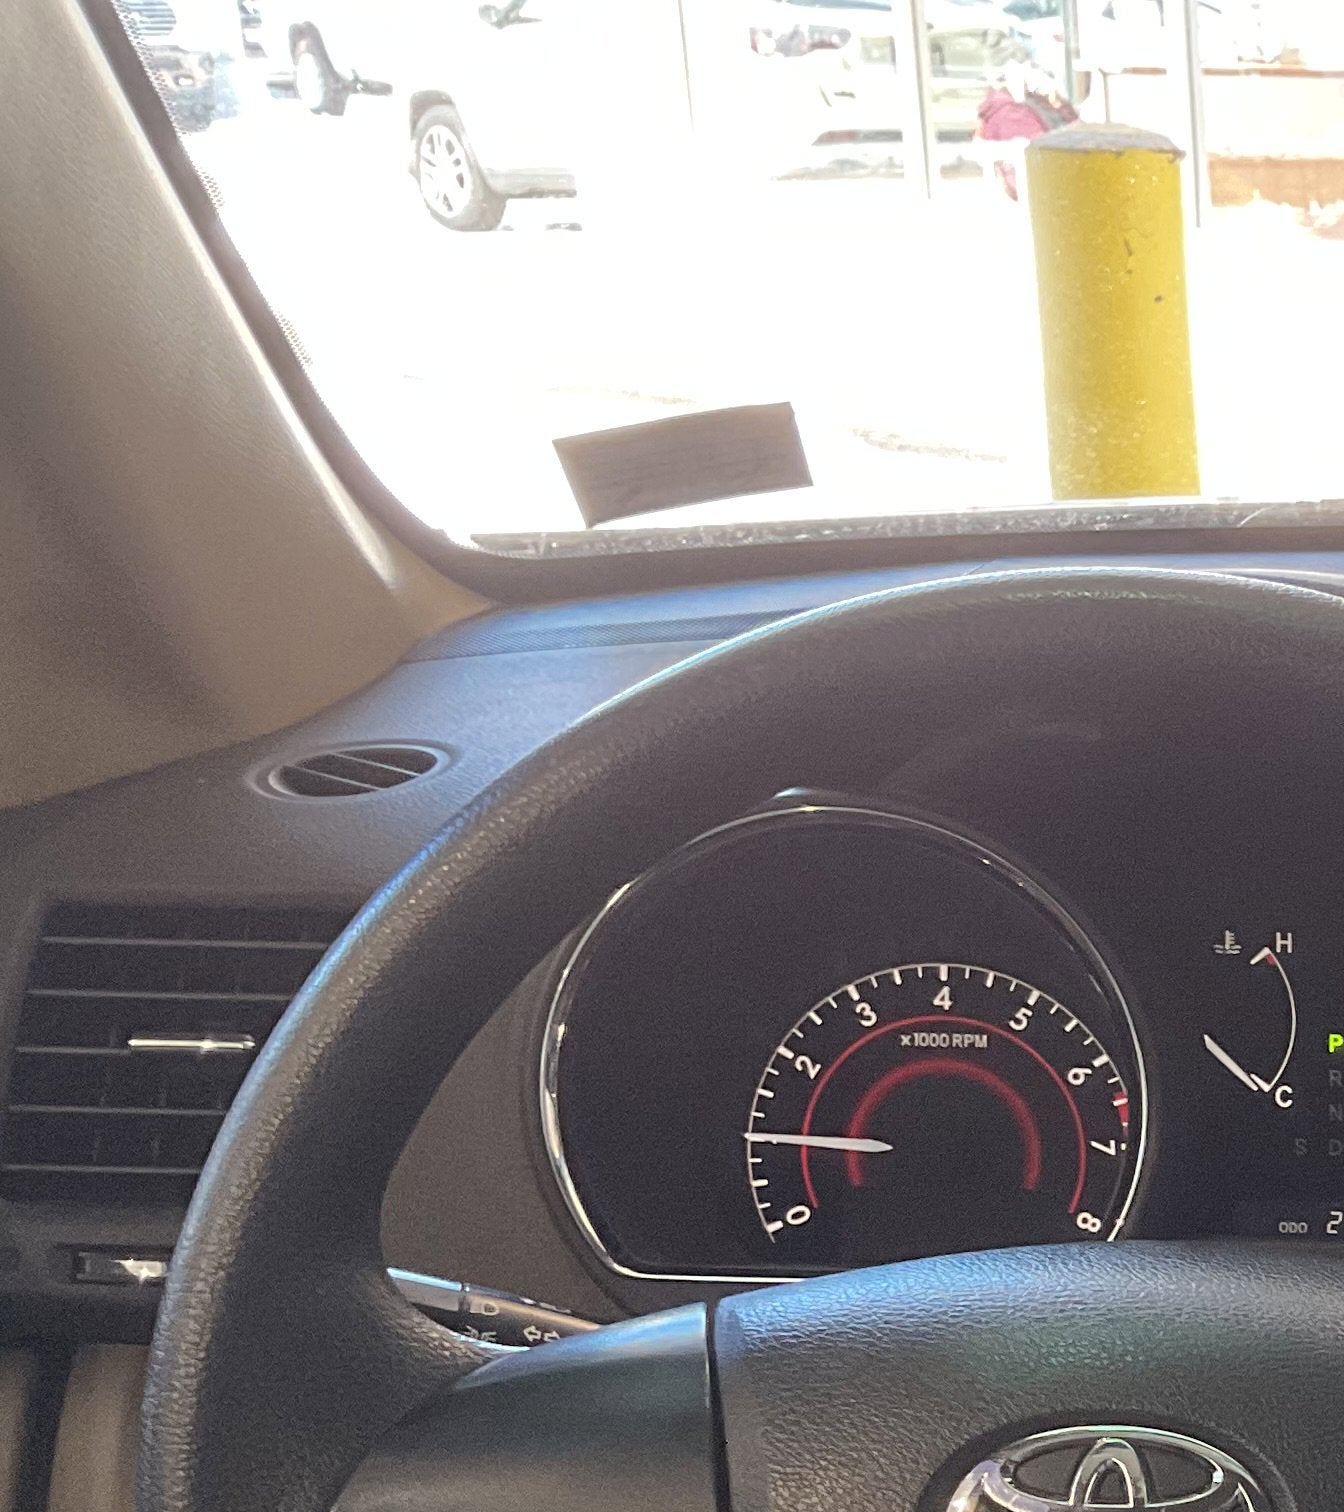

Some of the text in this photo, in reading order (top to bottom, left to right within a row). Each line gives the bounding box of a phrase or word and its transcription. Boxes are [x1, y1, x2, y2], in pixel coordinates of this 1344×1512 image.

[1276, 932, 1292, 953] H
[933, 986, 952, 1010] 4
[855, 1002, 877, 1026] 3
[1009, 1007, 1029, 1030] 5
[952, 1033, 988, 1048] RPM
[1328, 1034, 1344, 1052] P
[795, 1056, 821, 1079] 2
[1067, 1066, 1092, 1086] 6
[1329, 1070, 1342, 1087] R
[1275, 1085, 1293, 1108] C
[1090, 1139, 1116, 1155] 7
[786, 1205, 811, 1226] 0
[1076, 1211, 1101, 1233] 8
[1279, 1222, 1307, 1233] ODO
